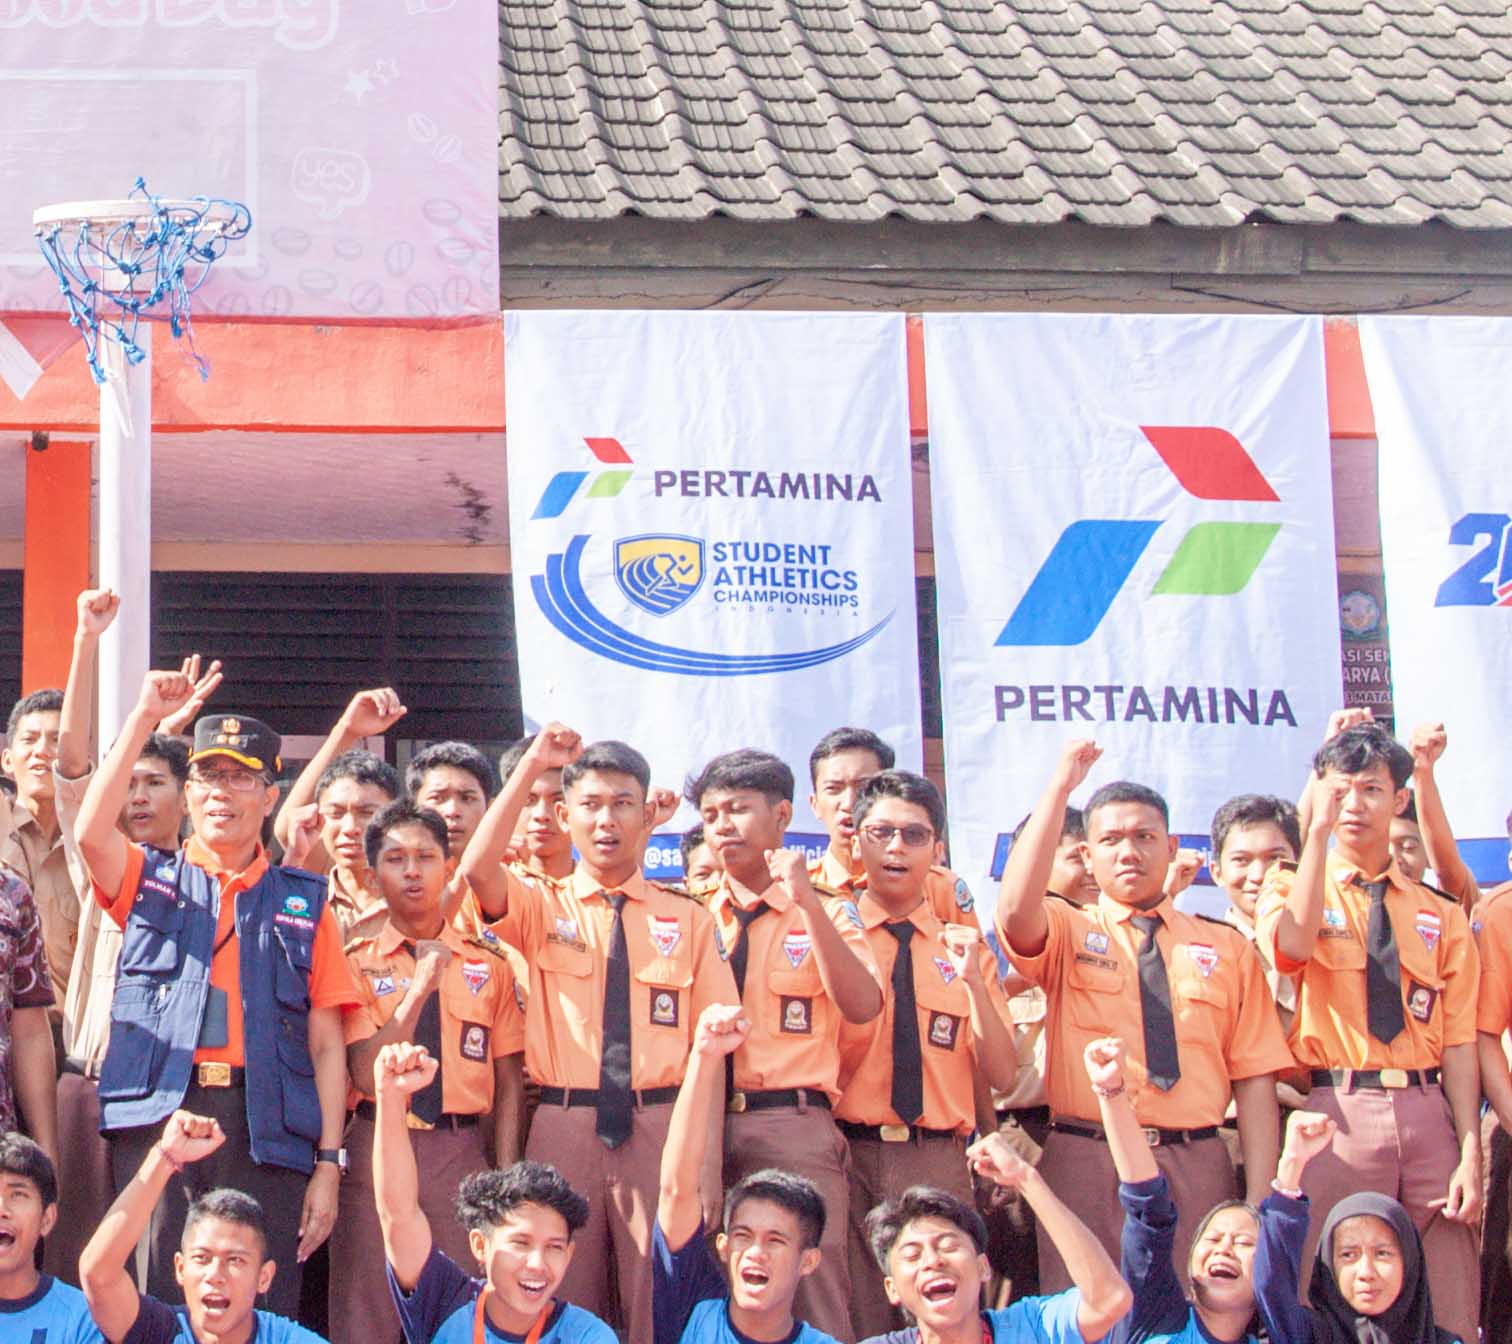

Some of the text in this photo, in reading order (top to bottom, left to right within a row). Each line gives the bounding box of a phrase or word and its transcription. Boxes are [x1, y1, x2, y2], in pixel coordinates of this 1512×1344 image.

[653, 469, 882, 502] PERTAMINA
[712, 541, 832, 566] STUDENT
[712, 565, 858, 591] ATHLETICS
[713, 590, 859, 608] CHAMPIONSHIPS
[993, 684, 1299, 728] PERTAMINA
